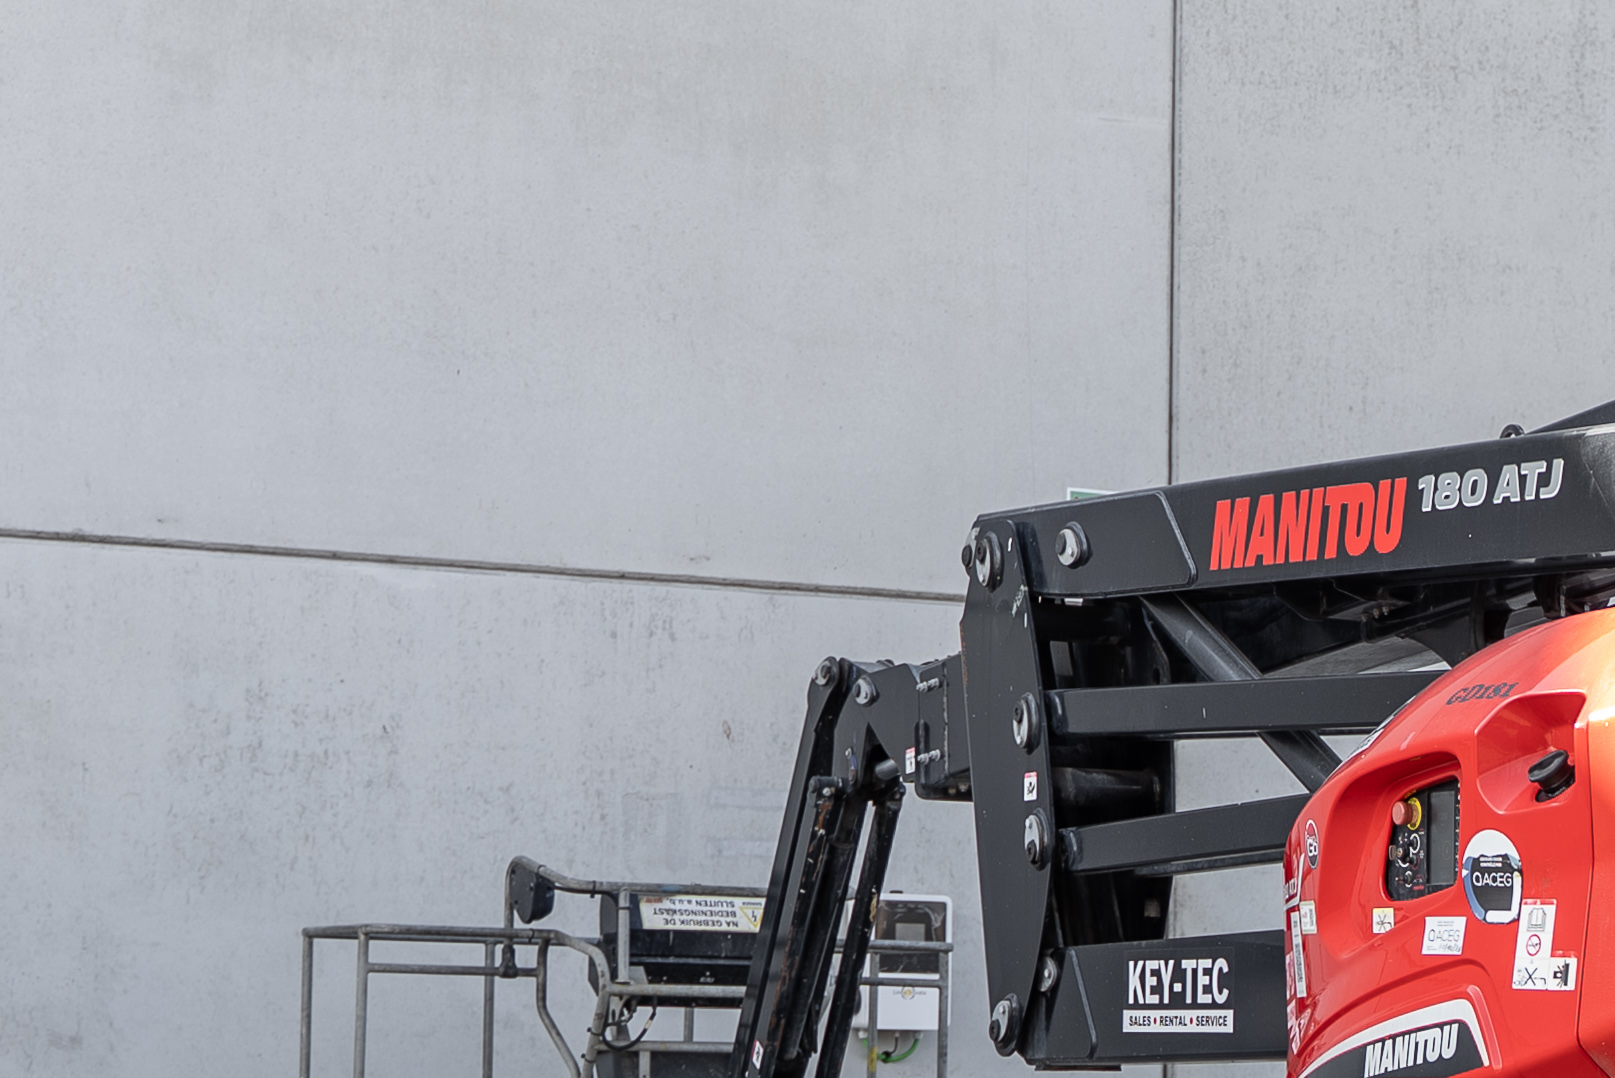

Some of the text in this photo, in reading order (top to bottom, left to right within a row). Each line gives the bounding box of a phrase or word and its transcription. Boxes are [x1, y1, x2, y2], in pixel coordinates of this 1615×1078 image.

[1209, 458, 1564, 571] MANITOU 180 ATJ
[695, 899, 735, 908] SLUITEN
[663, 917, 739, 928] NA GEBRUIK DE
[1127, 957, 1230, 1005] KEY-TEC
[1128, 1014, 1228, 1027] SALES RENTAL SERVICE
[1363, 1023, 1459, 1078] MANITOU
